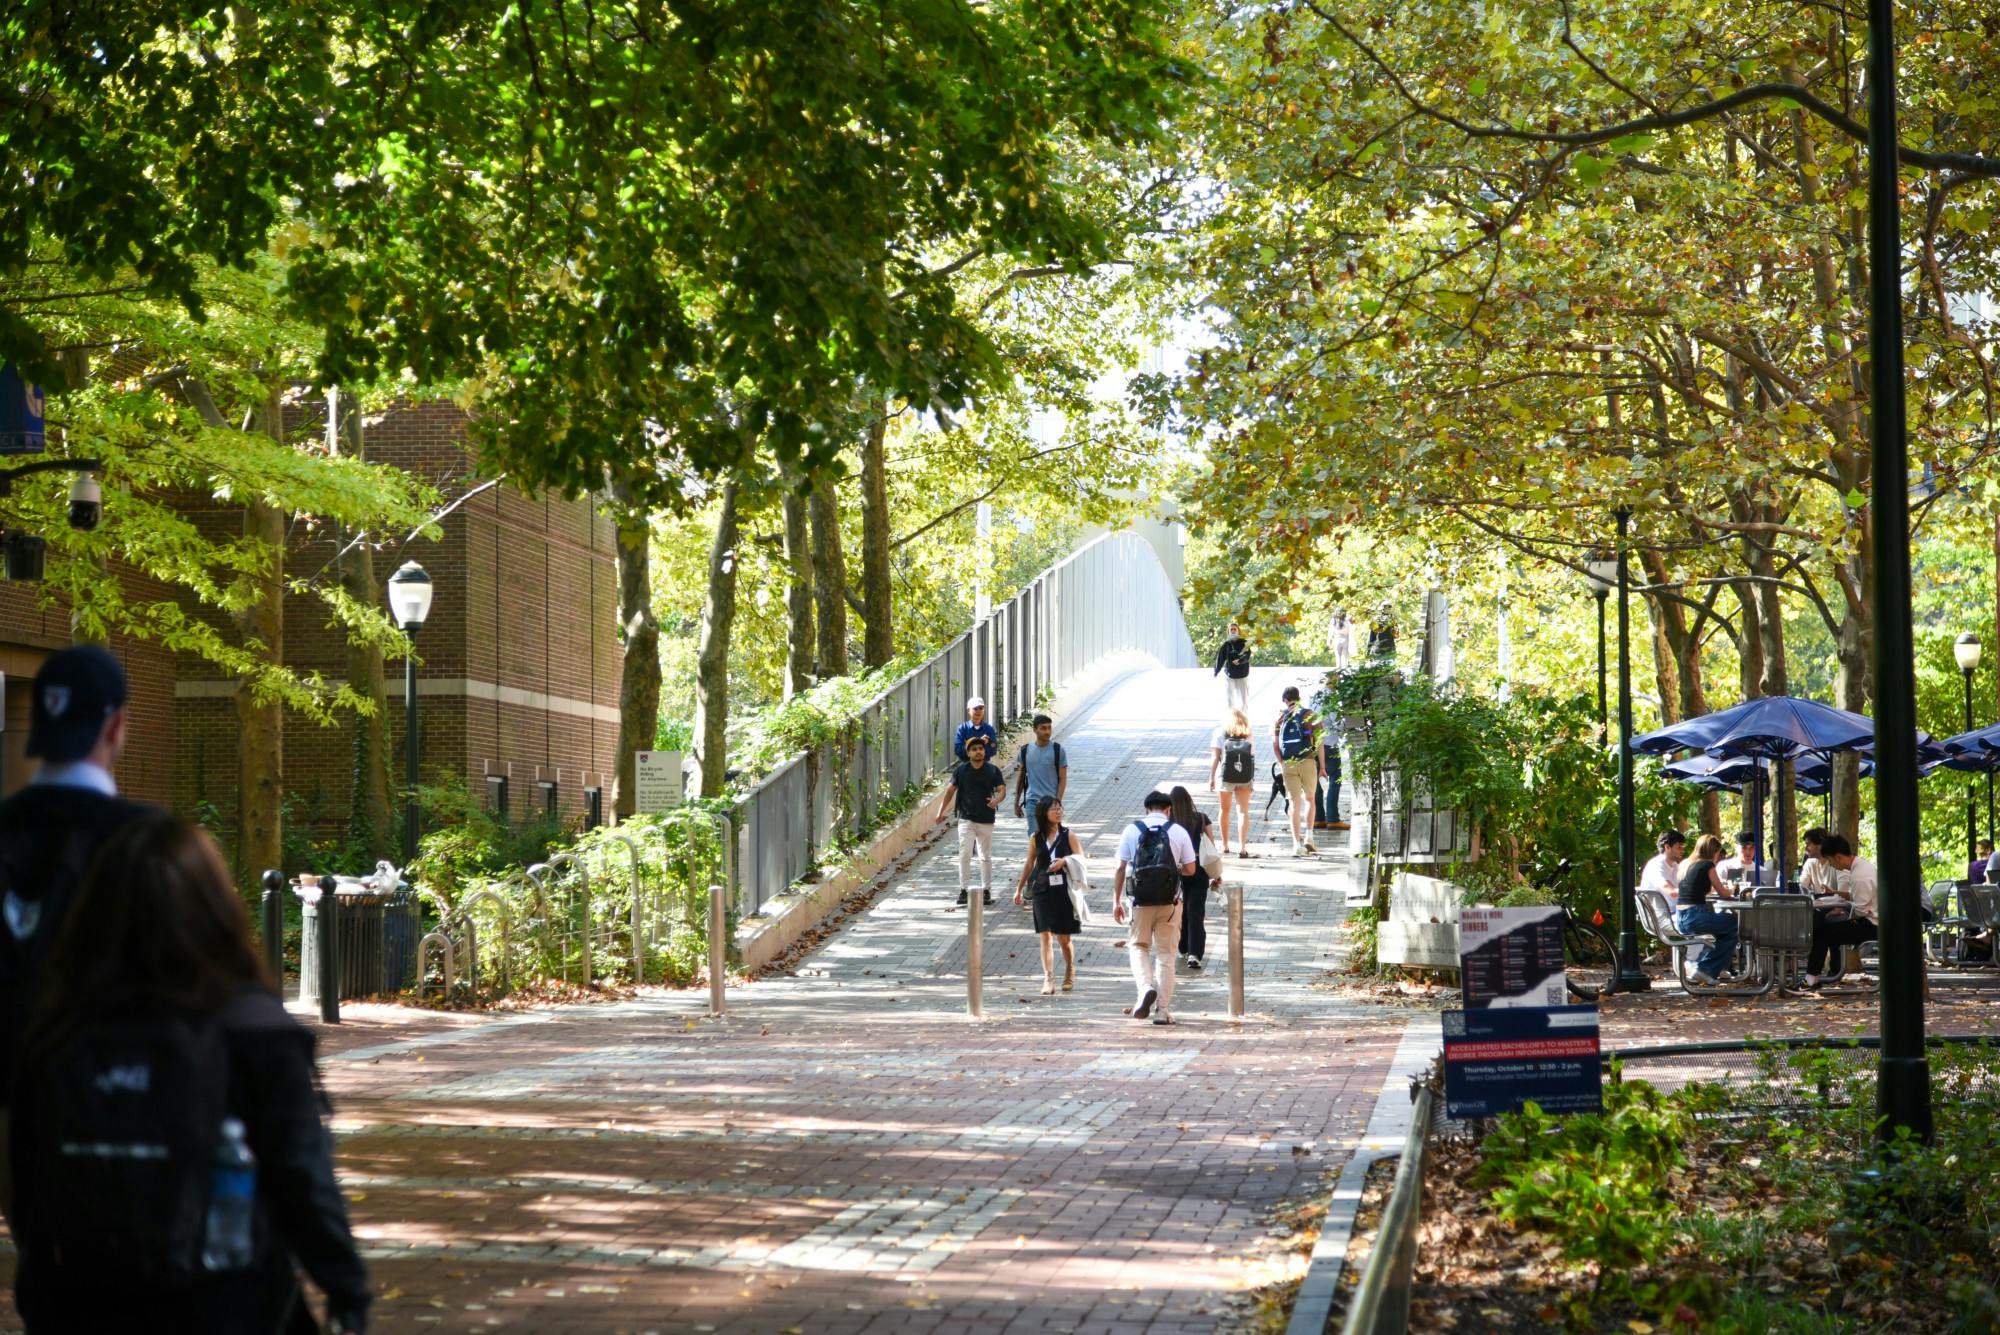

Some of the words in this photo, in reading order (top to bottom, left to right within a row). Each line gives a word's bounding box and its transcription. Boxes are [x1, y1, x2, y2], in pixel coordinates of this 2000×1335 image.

[1461, 922, 1488, 932] DINNERS
[1450, 1043, 1499, 1052] ACCELERATED
[1501, 1041, 1545, 1050] BACHELOR'S
[1557, 1039, 1592, 1048] MASTER'S
[1449, 1052, 1476, 1060] DEGREE
[1478, 1050, 1514, 1058] PROGRAM
[1516, 1049, 1564, 1057] INFORMATION
[1566, 1047, 1596, 1055] SESSION
[1497, 1064, 1525, 1072] October
